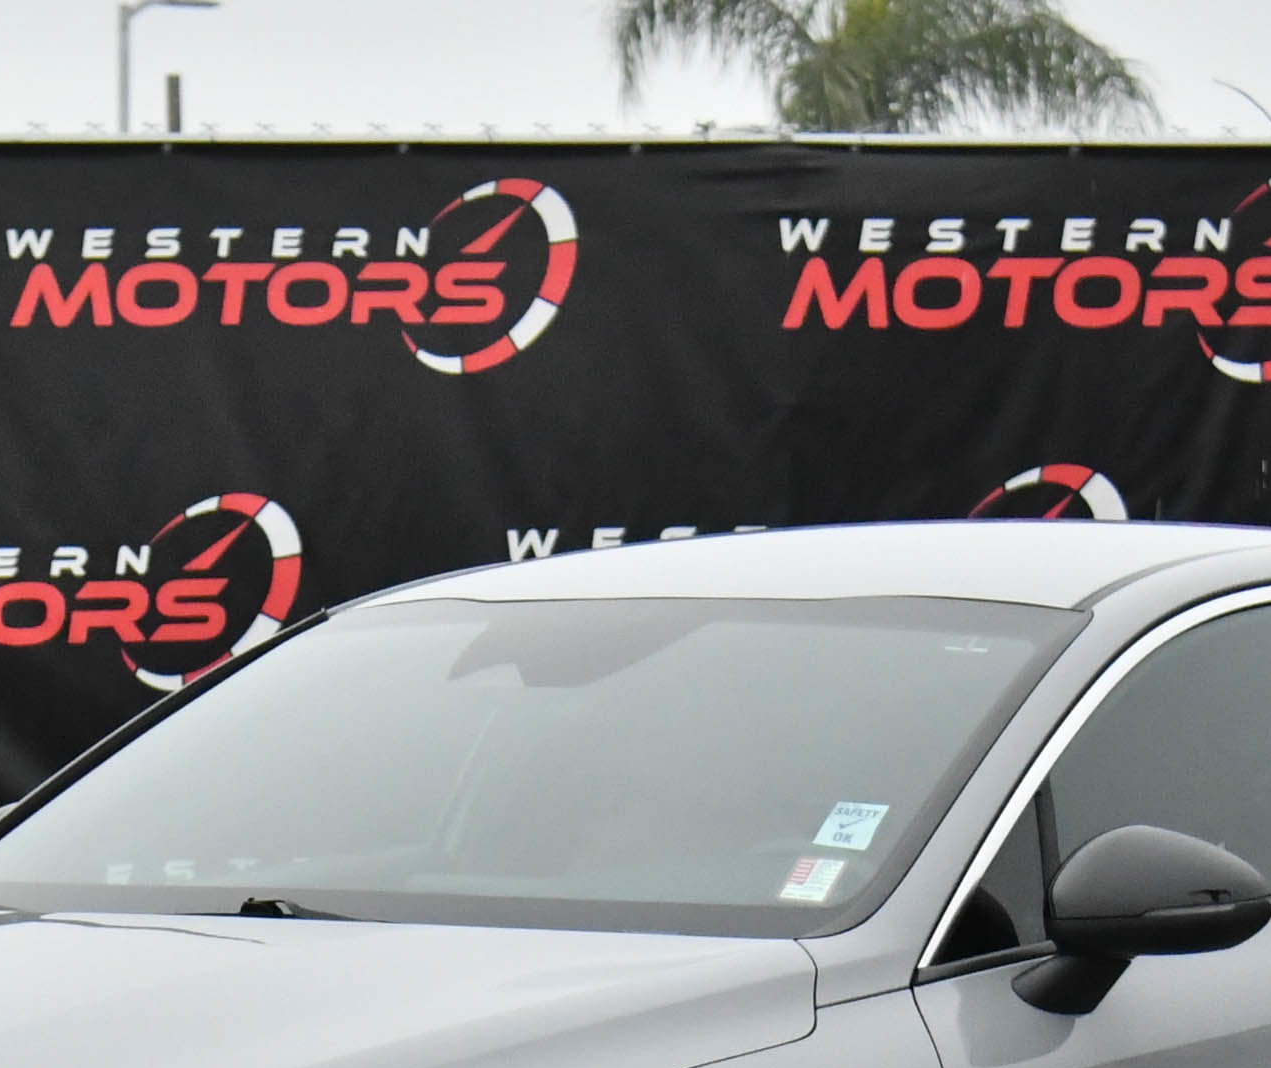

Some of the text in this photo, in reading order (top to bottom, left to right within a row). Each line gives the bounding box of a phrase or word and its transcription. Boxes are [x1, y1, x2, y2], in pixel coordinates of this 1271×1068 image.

[5, 226, 430, 259] WESTERN
[779, 218, 1231, 253] WESTERN
[10, 261, 507, 329] MOTORS
[834, 806, 882, 819] SAFETY
